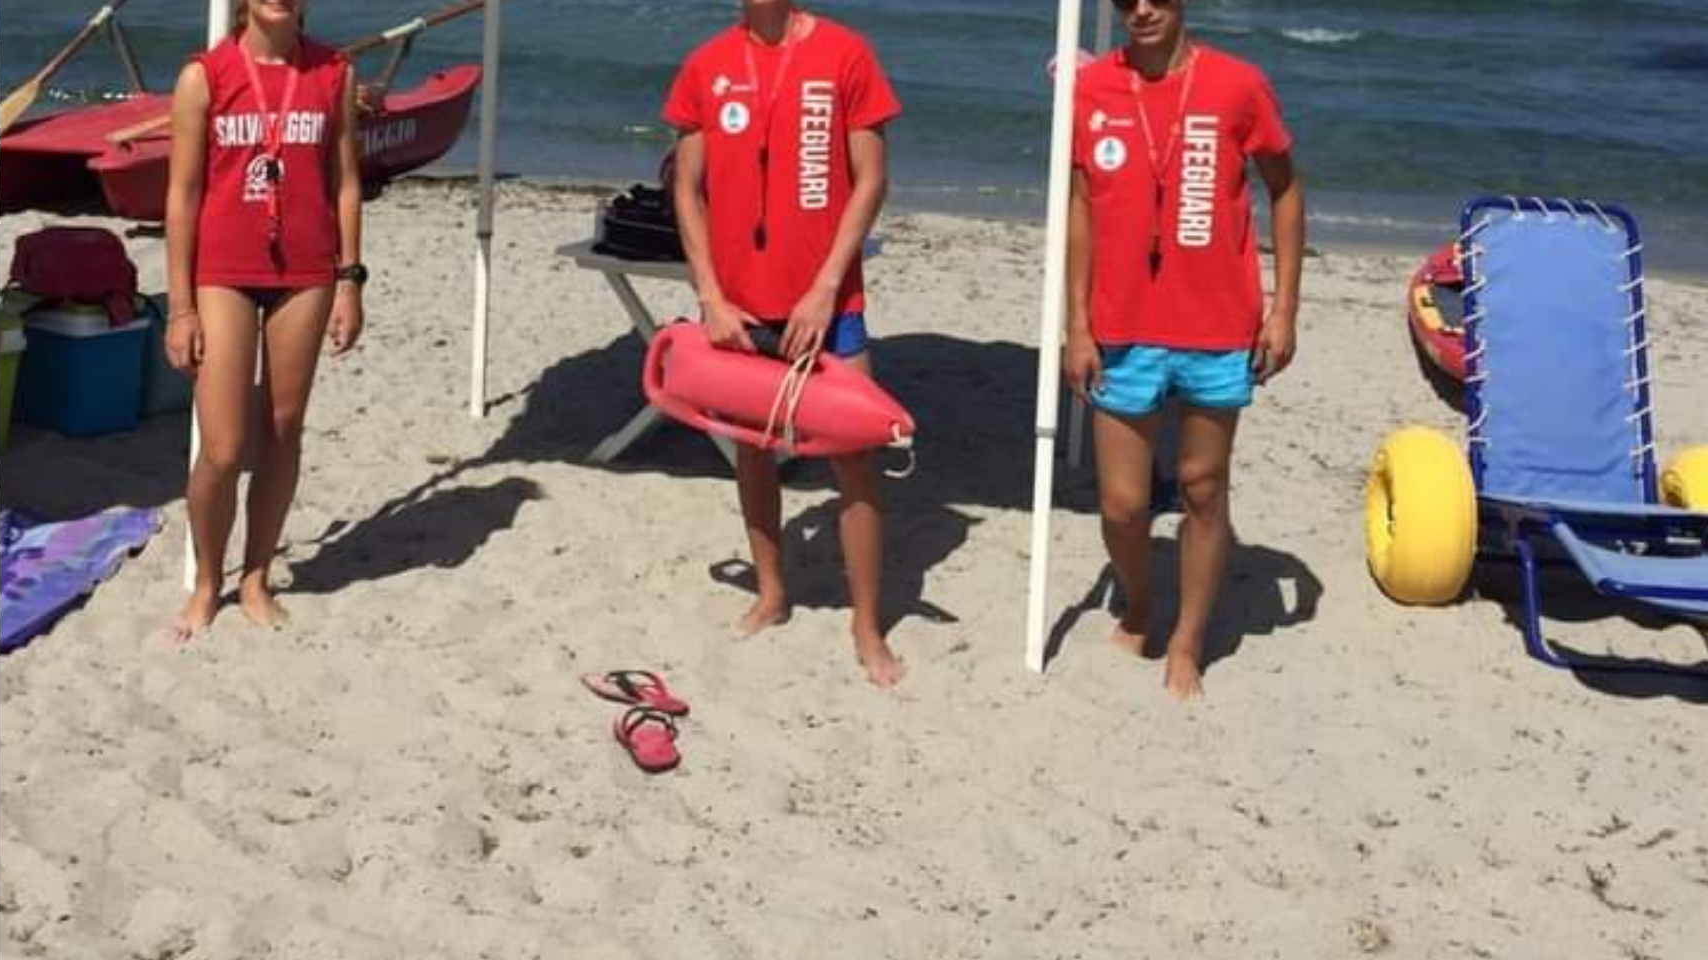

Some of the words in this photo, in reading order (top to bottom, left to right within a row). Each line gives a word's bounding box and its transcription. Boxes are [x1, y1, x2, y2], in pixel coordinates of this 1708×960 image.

[214, 110, 326, 148] SALVTGGI
[798, 79, 835, 211] LIFEGUARD
[1176, 115, 1220, 246] LIFEGUARD
